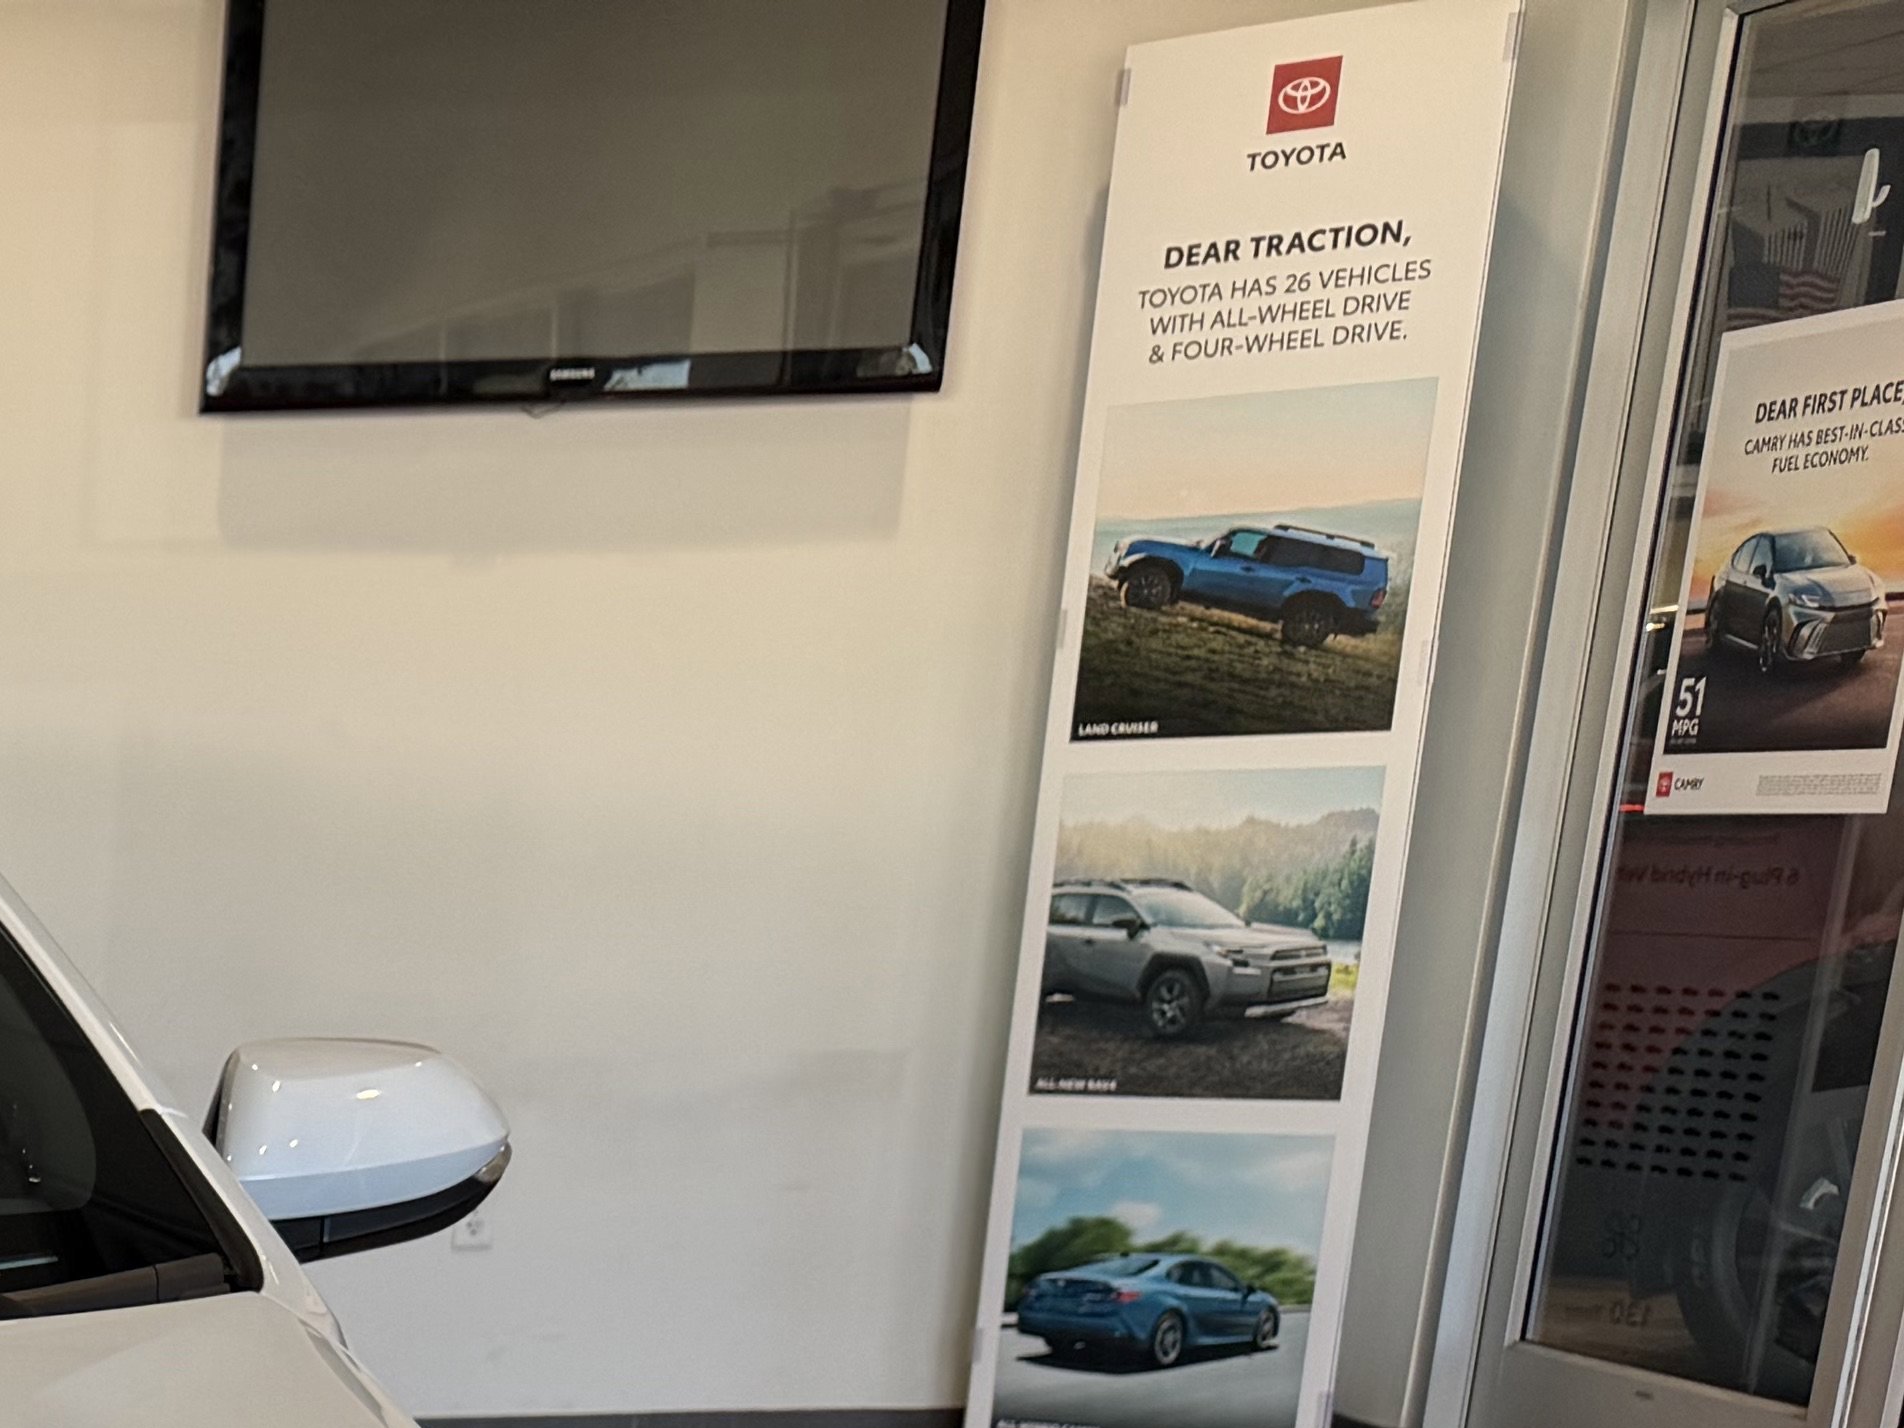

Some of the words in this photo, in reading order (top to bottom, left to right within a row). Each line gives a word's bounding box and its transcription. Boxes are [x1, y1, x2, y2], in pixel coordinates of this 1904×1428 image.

[1247, 142, 1346, 172] TOYOTA
[1164, 239, 1240, 269] DEAR
[1250, 219, 1411, 259] TRACTION,
[1139, 282, 1223, 310] TOYOTA
[1231, 275, 1277, 300] HAS
[1284, 272, 1311, 293] 26
[1319, 259, 1431, 289] VEHICLES
[1150, 312, 1204, 335] WITH
[1210, 298, 1335, 329] ALL-WHEEL
[1343, 290, 1411, 316] DRIVE
[1149, 345, 1164, 364] &
[1171, 328, 1324, 361] FOUR-WHEEL
[1333, 320, 1407, 346] DRIVE.
[1755, 397, 1798, 424] DEAR
[1802, 388, 1848, 416] FIRST
[1745, 433, 1787, 455] CAMRY
[1788, 430, 1813, 450] HAS
[1816, 416, 1904, 445] BEST-IN-CLAS
[1772, 454, 1800, 474] FUEL
[1803, 445, 1869, 470] ECONOMY.
[1675, 676, 1706, 717] 51
[1078, 722, 1109, 737] LAND
[1110, 720, 1159, 735] CRUISER
[1671, 718, 1699, 736] MPG
[1674, 777, 1704, 791] CAMRY
